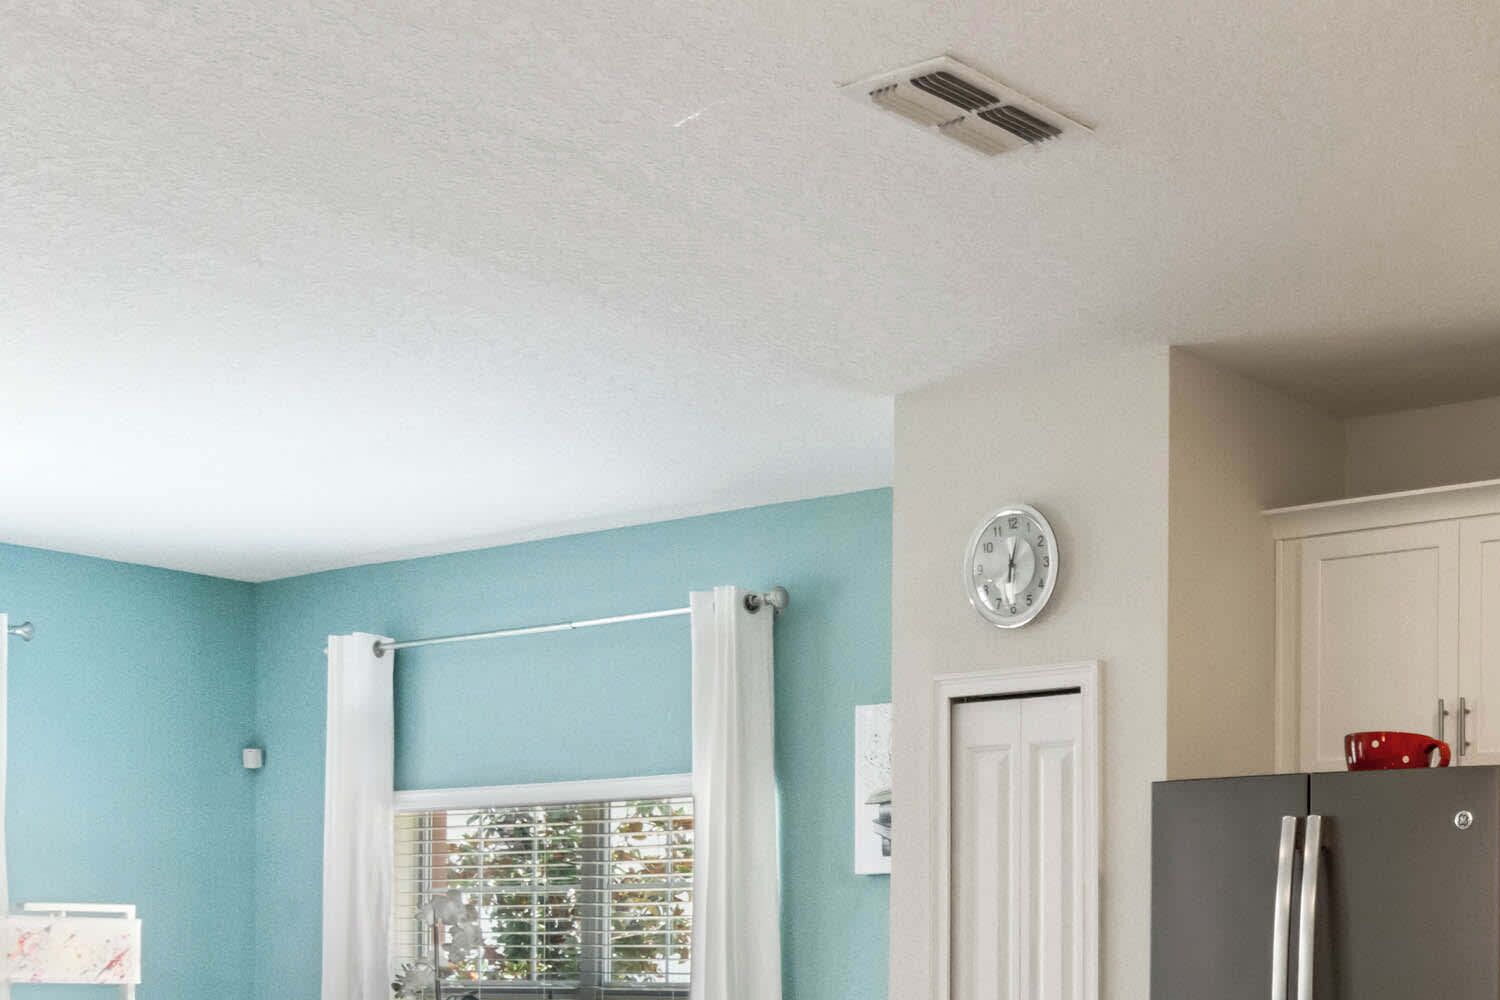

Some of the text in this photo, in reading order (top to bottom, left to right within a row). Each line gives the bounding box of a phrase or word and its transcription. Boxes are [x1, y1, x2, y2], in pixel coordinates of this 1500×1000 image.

[1008, 517, 1018, 529] 12
[1026, 522, 1031, 533] 1
[993, 527, 1002, 537] 11
[1037, 535, 1044, 547] 2
[983, 542, 994, 553] 10
[1043, 556, 1050, 567] 3
[1038, 578, 1044, 588] 4
[995, 598, 1002, 610] 7
[1026, 594, 1033, 606] 5
